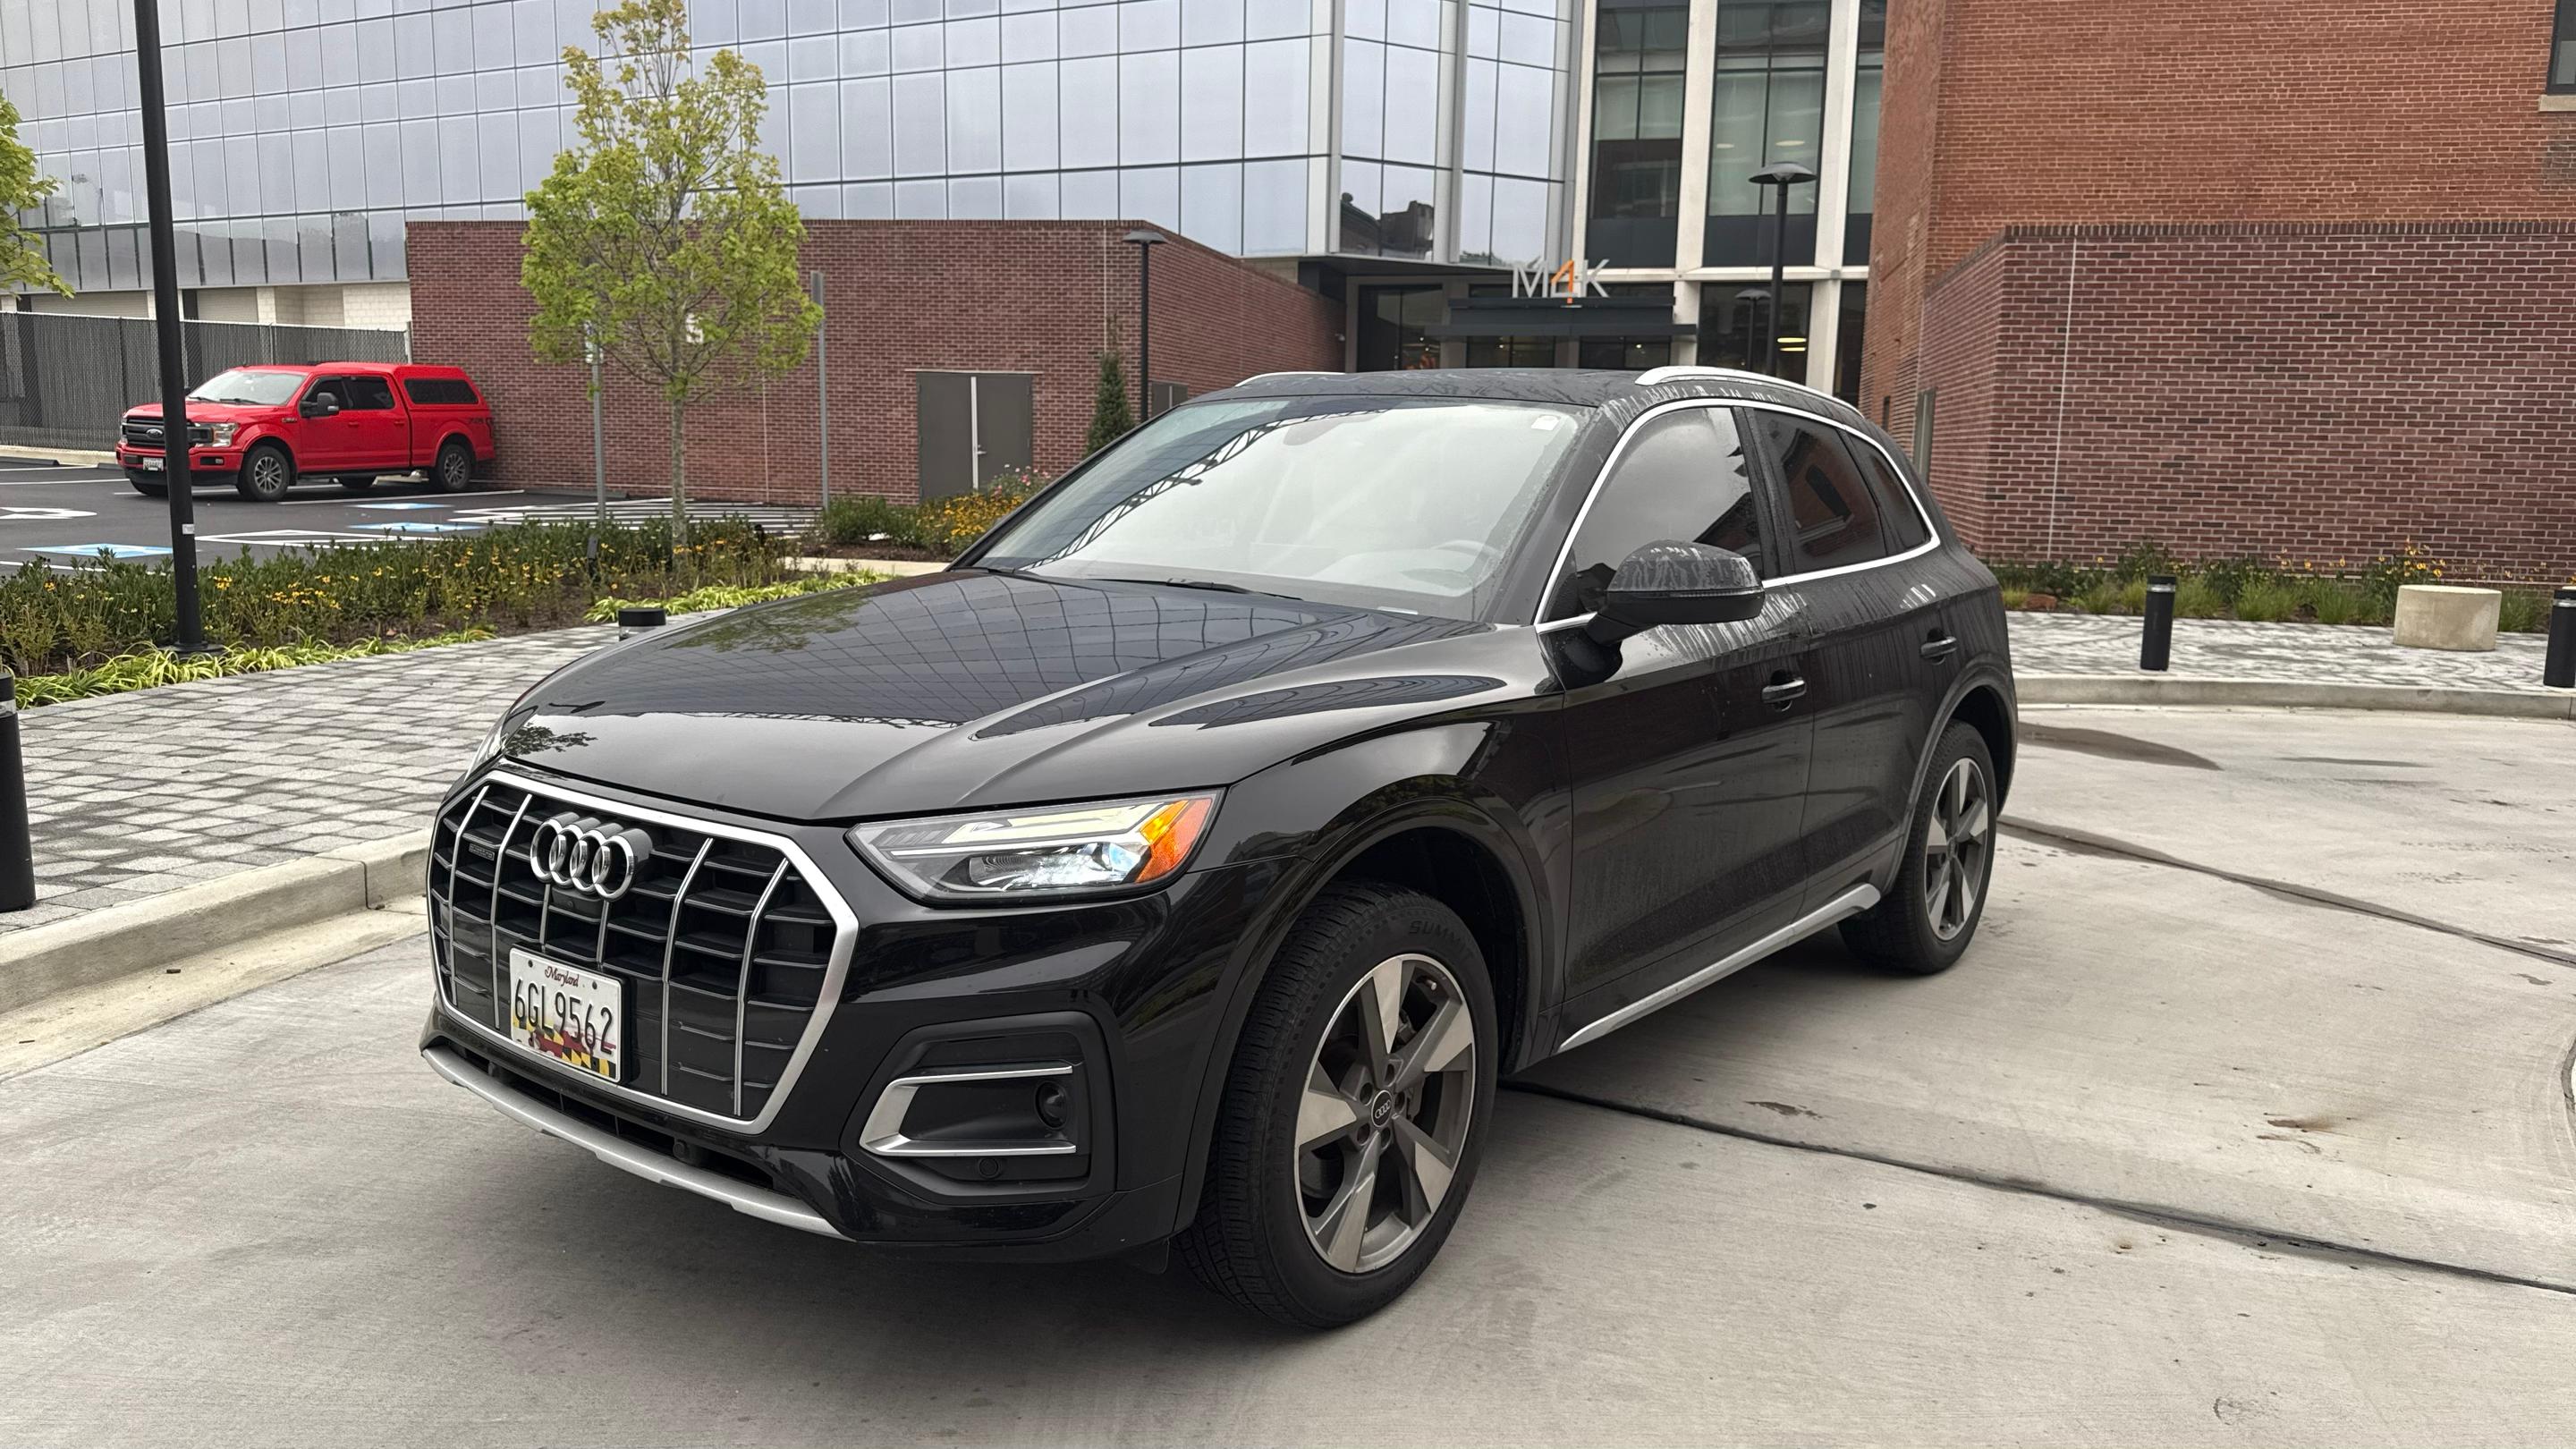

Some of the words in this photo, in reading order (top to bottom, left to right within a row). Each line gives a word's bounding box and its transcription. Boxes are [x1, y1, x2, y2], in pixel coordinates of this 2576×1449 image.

[1512, 258, 1610, 303] M4K
[545, 966, 580, 987] Maryland
[515, 979, 612, 1055] 6GL9562
